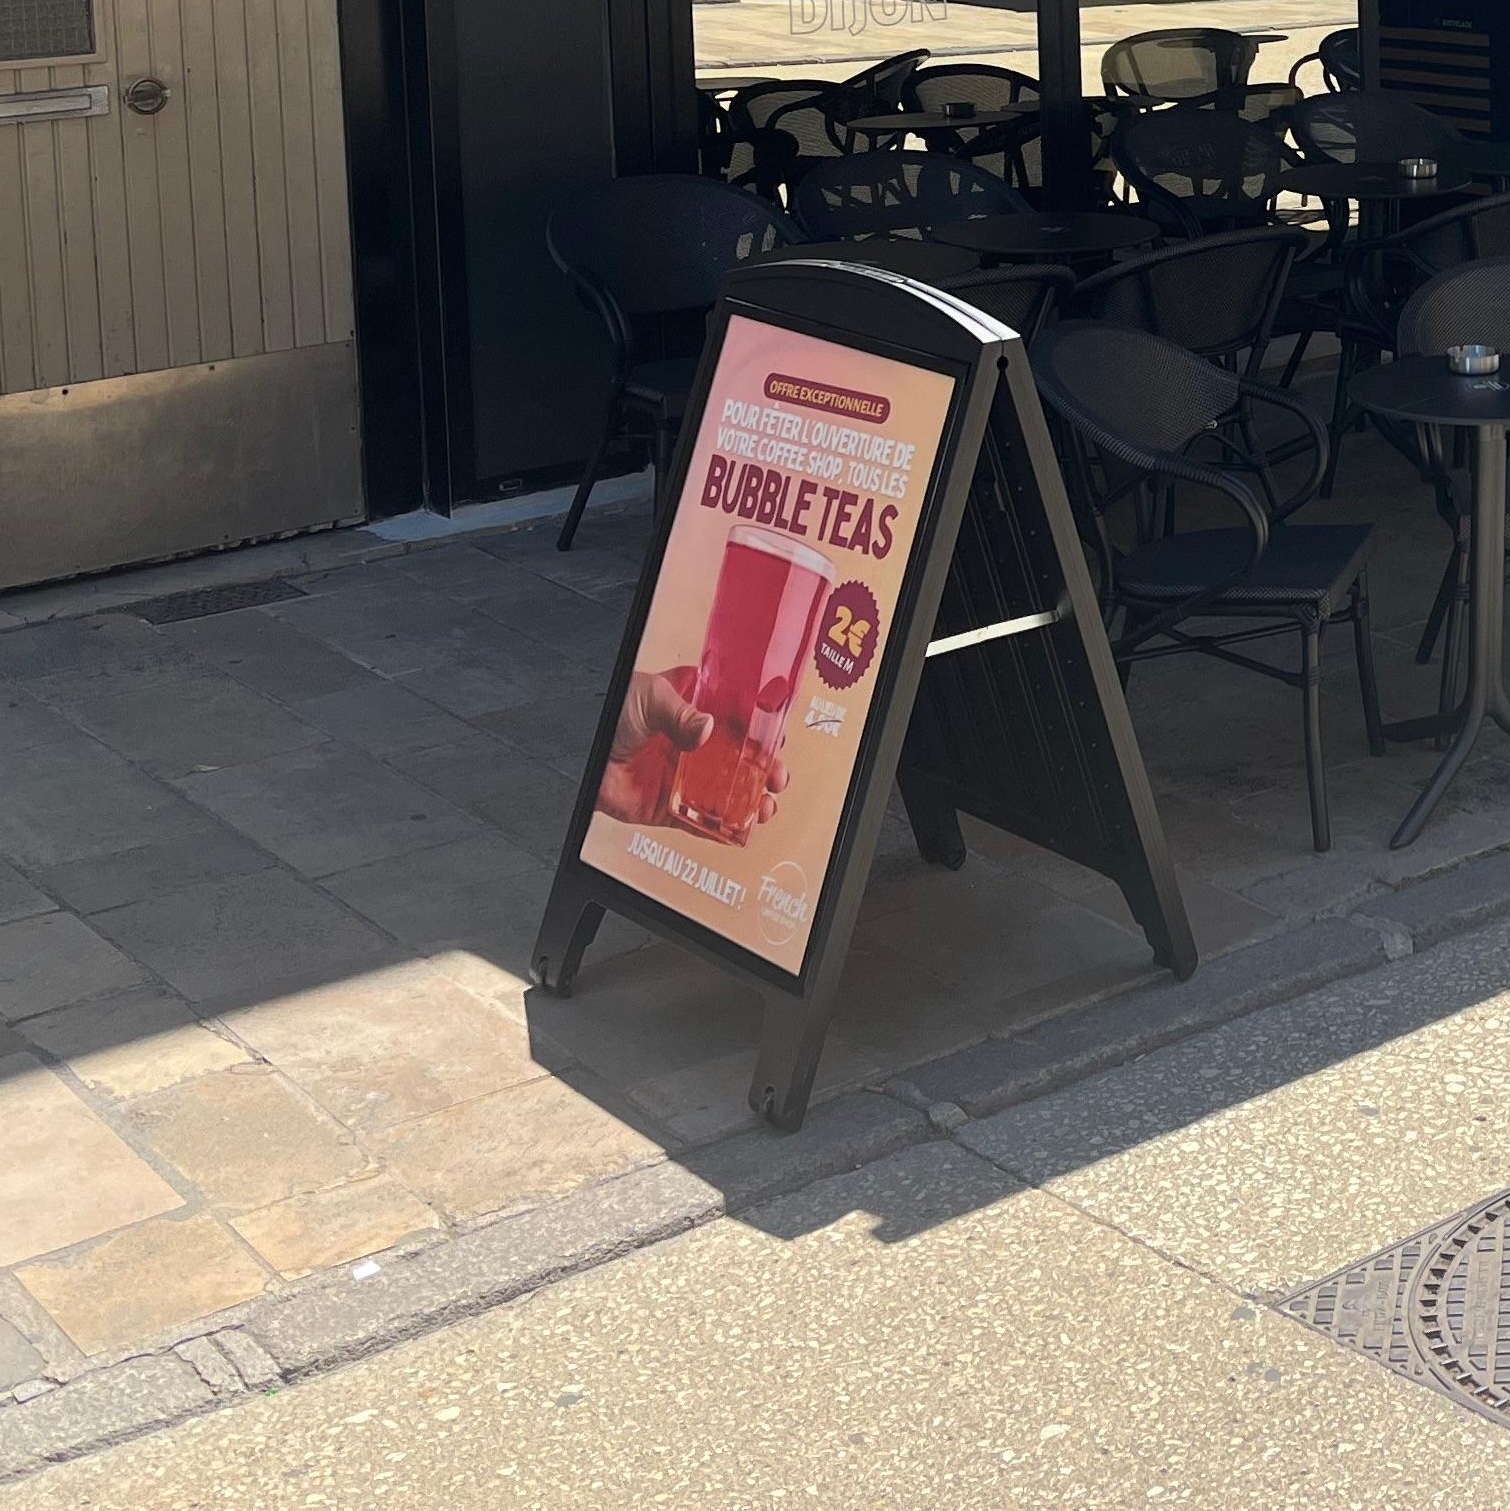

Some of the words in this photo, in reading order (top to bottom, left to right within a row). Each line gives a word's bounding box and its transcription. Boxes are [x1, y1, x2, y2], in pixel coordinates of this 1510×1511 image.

[769, 380, 800, 397] OFFRE
[800, 386, 884, 417] EXCEPTIONNELLE
[721, 399, 760, 430] POUR
[759, 401, 801, 441] FÊTER
[802, 417, 895, 465] L'OUVERTURE
[892, 441, 916, 471] DE
[716, 427, 757, 457] VOTRE
[757, 435, 807, 472] COFFEE
[808, 450, 844, 484] SHOP,
[848, 459, 882, 492] TOUS
[881, 470, 909, 499] LES
[701, 453, 818, 536] BUBBLE
[817, 486, 899, 560] TEAS
[828, 605, 871, 658] 2€
[820, 643, 846, 670] TAILLE
[843, 658, 855, 675] M
[628, 831, 684, 877] JUSQU'AU
[681, 859, 699, 886] 22
[757, 875, 809, 922] French
